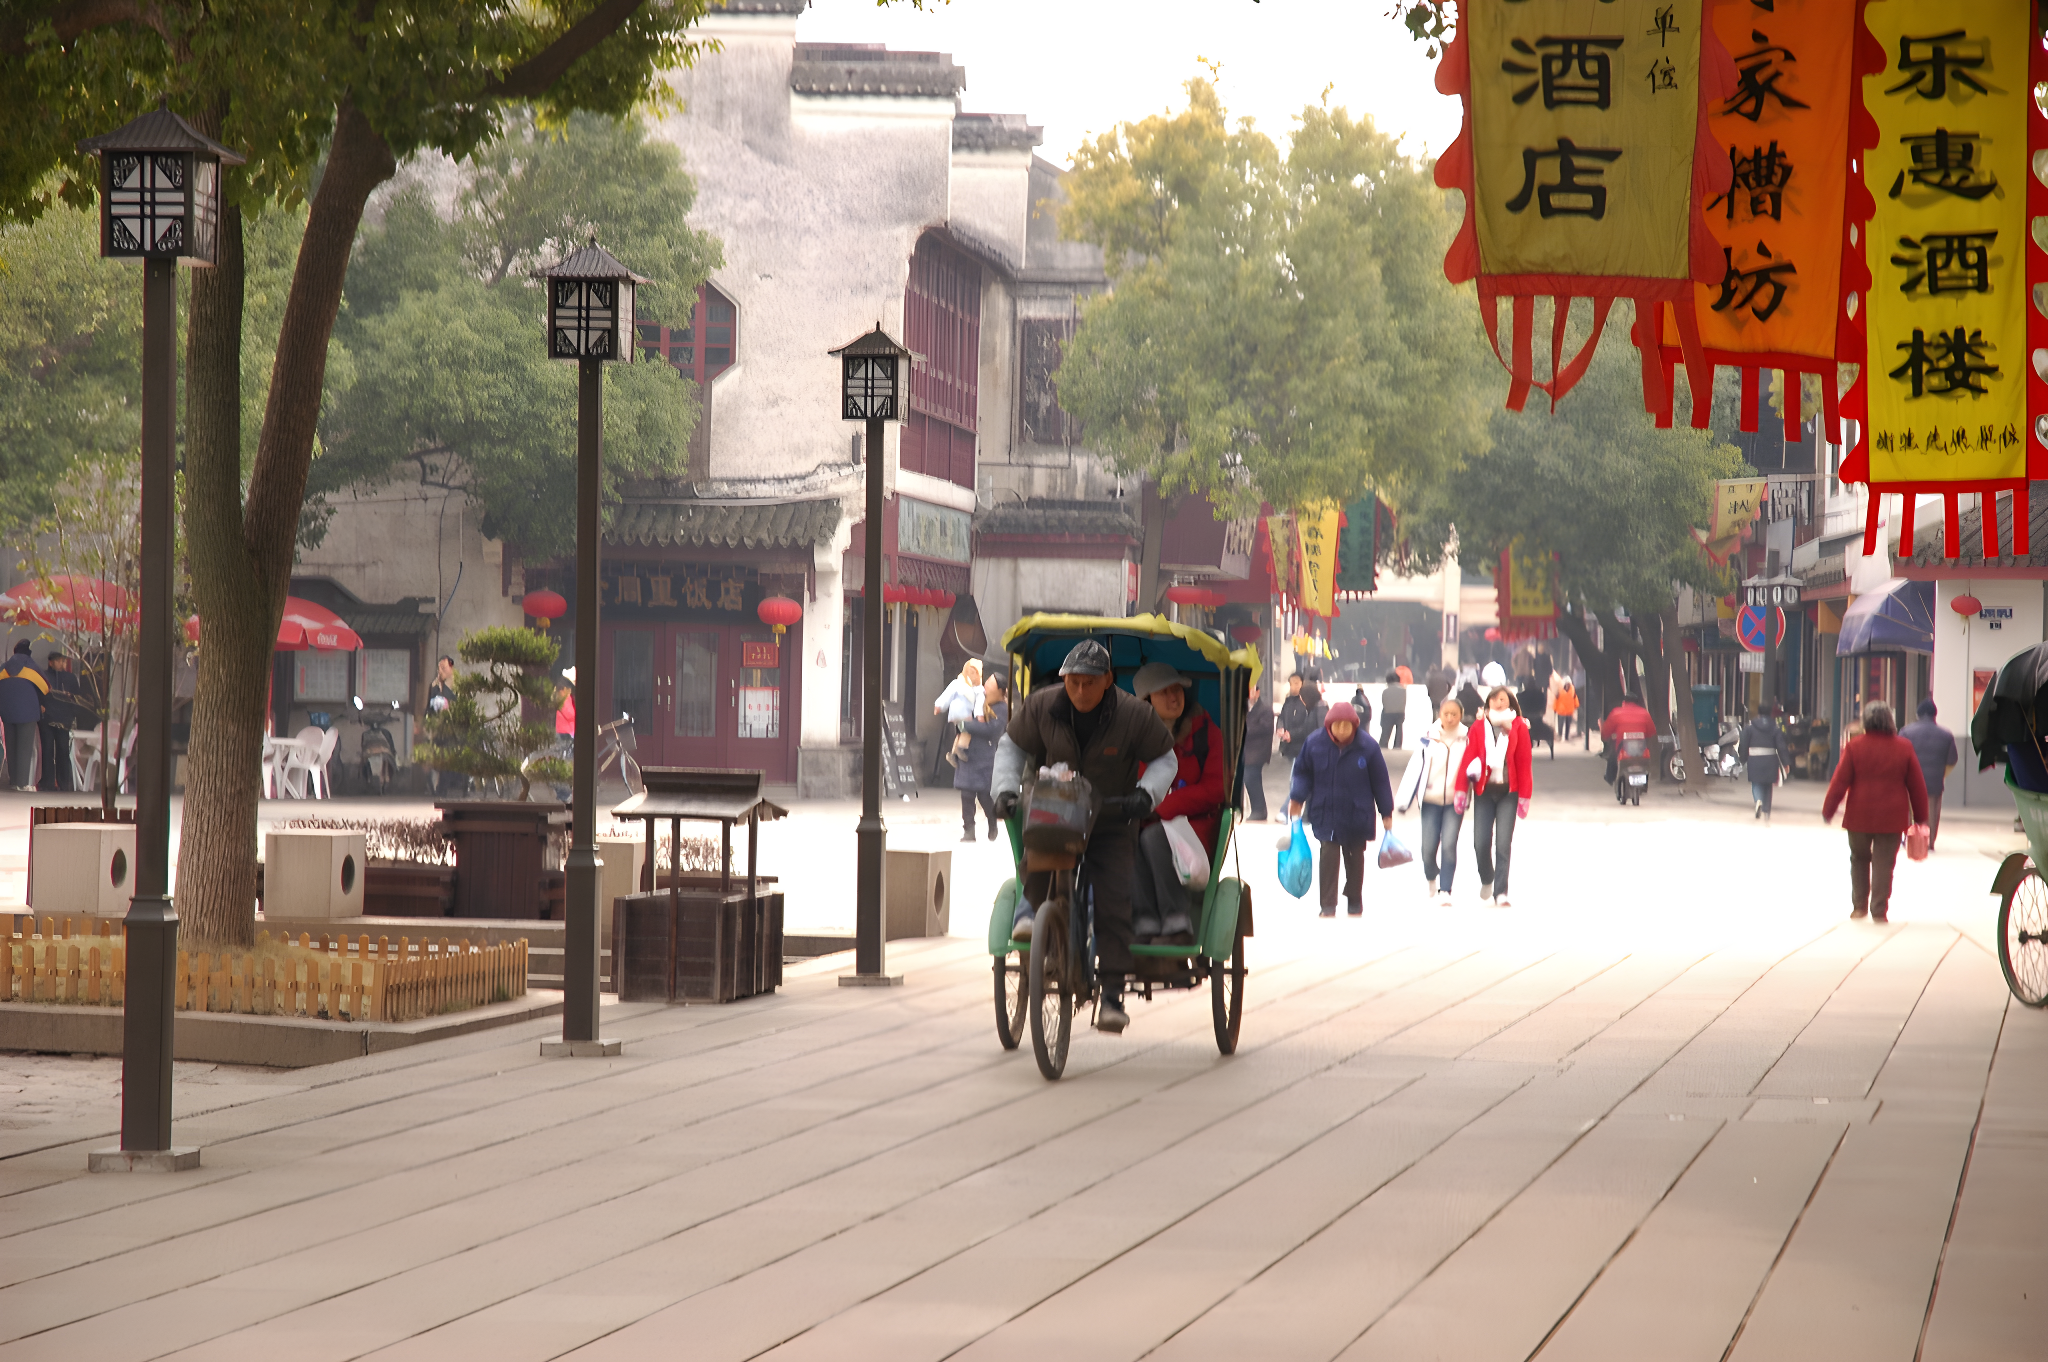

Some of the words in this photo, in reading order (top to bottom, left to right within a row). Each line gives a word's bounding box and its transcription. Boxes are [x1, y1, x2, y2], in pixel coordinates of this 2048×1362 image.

[1502, 0, 1625, 220] 酒店
[1706, 0, 1811, 323] 家槽坊
[1884, 29, 2000, 398] 乐惠酒楼
